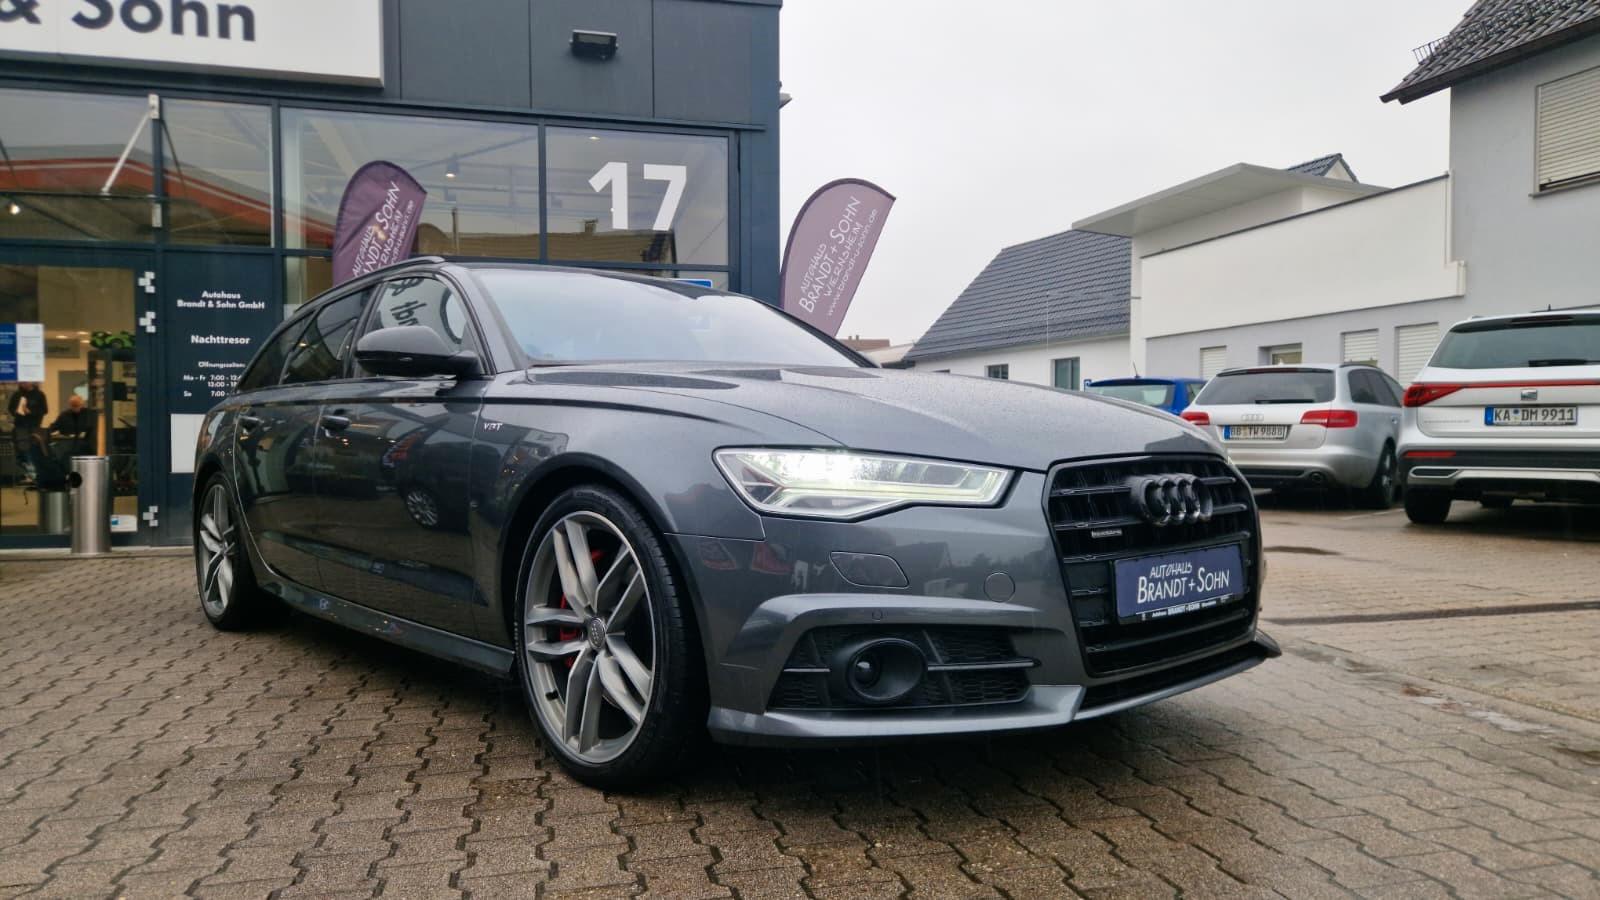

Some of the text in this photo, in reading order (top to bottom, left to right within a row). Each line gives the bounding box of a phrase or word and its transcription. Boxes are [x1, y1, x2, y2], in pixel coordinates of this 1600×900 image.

[72, 0, 256, 42] Sohn
[375, 181, 402, 230] SOHN
[588, 162, 687, 231] 17
[799, 196, 862, 313] BRANDT + SOHN
[800, 243, 827, 295] AUTOHAUS
[824, 221, 865, 297] WIERNSHEIM
[177, 299, 265, 309] Brandt & Sohn GmbH
[201, 290, 241, 299] Autohaus
[191, 334, 251, 344] Nachttresor
[1494, 409, 1574, 421] KA DM 9911
[1137, 567, 1230, 604] BRANDT + SOHN
[1149, 561, 1193, 578] AUTOHAUS
